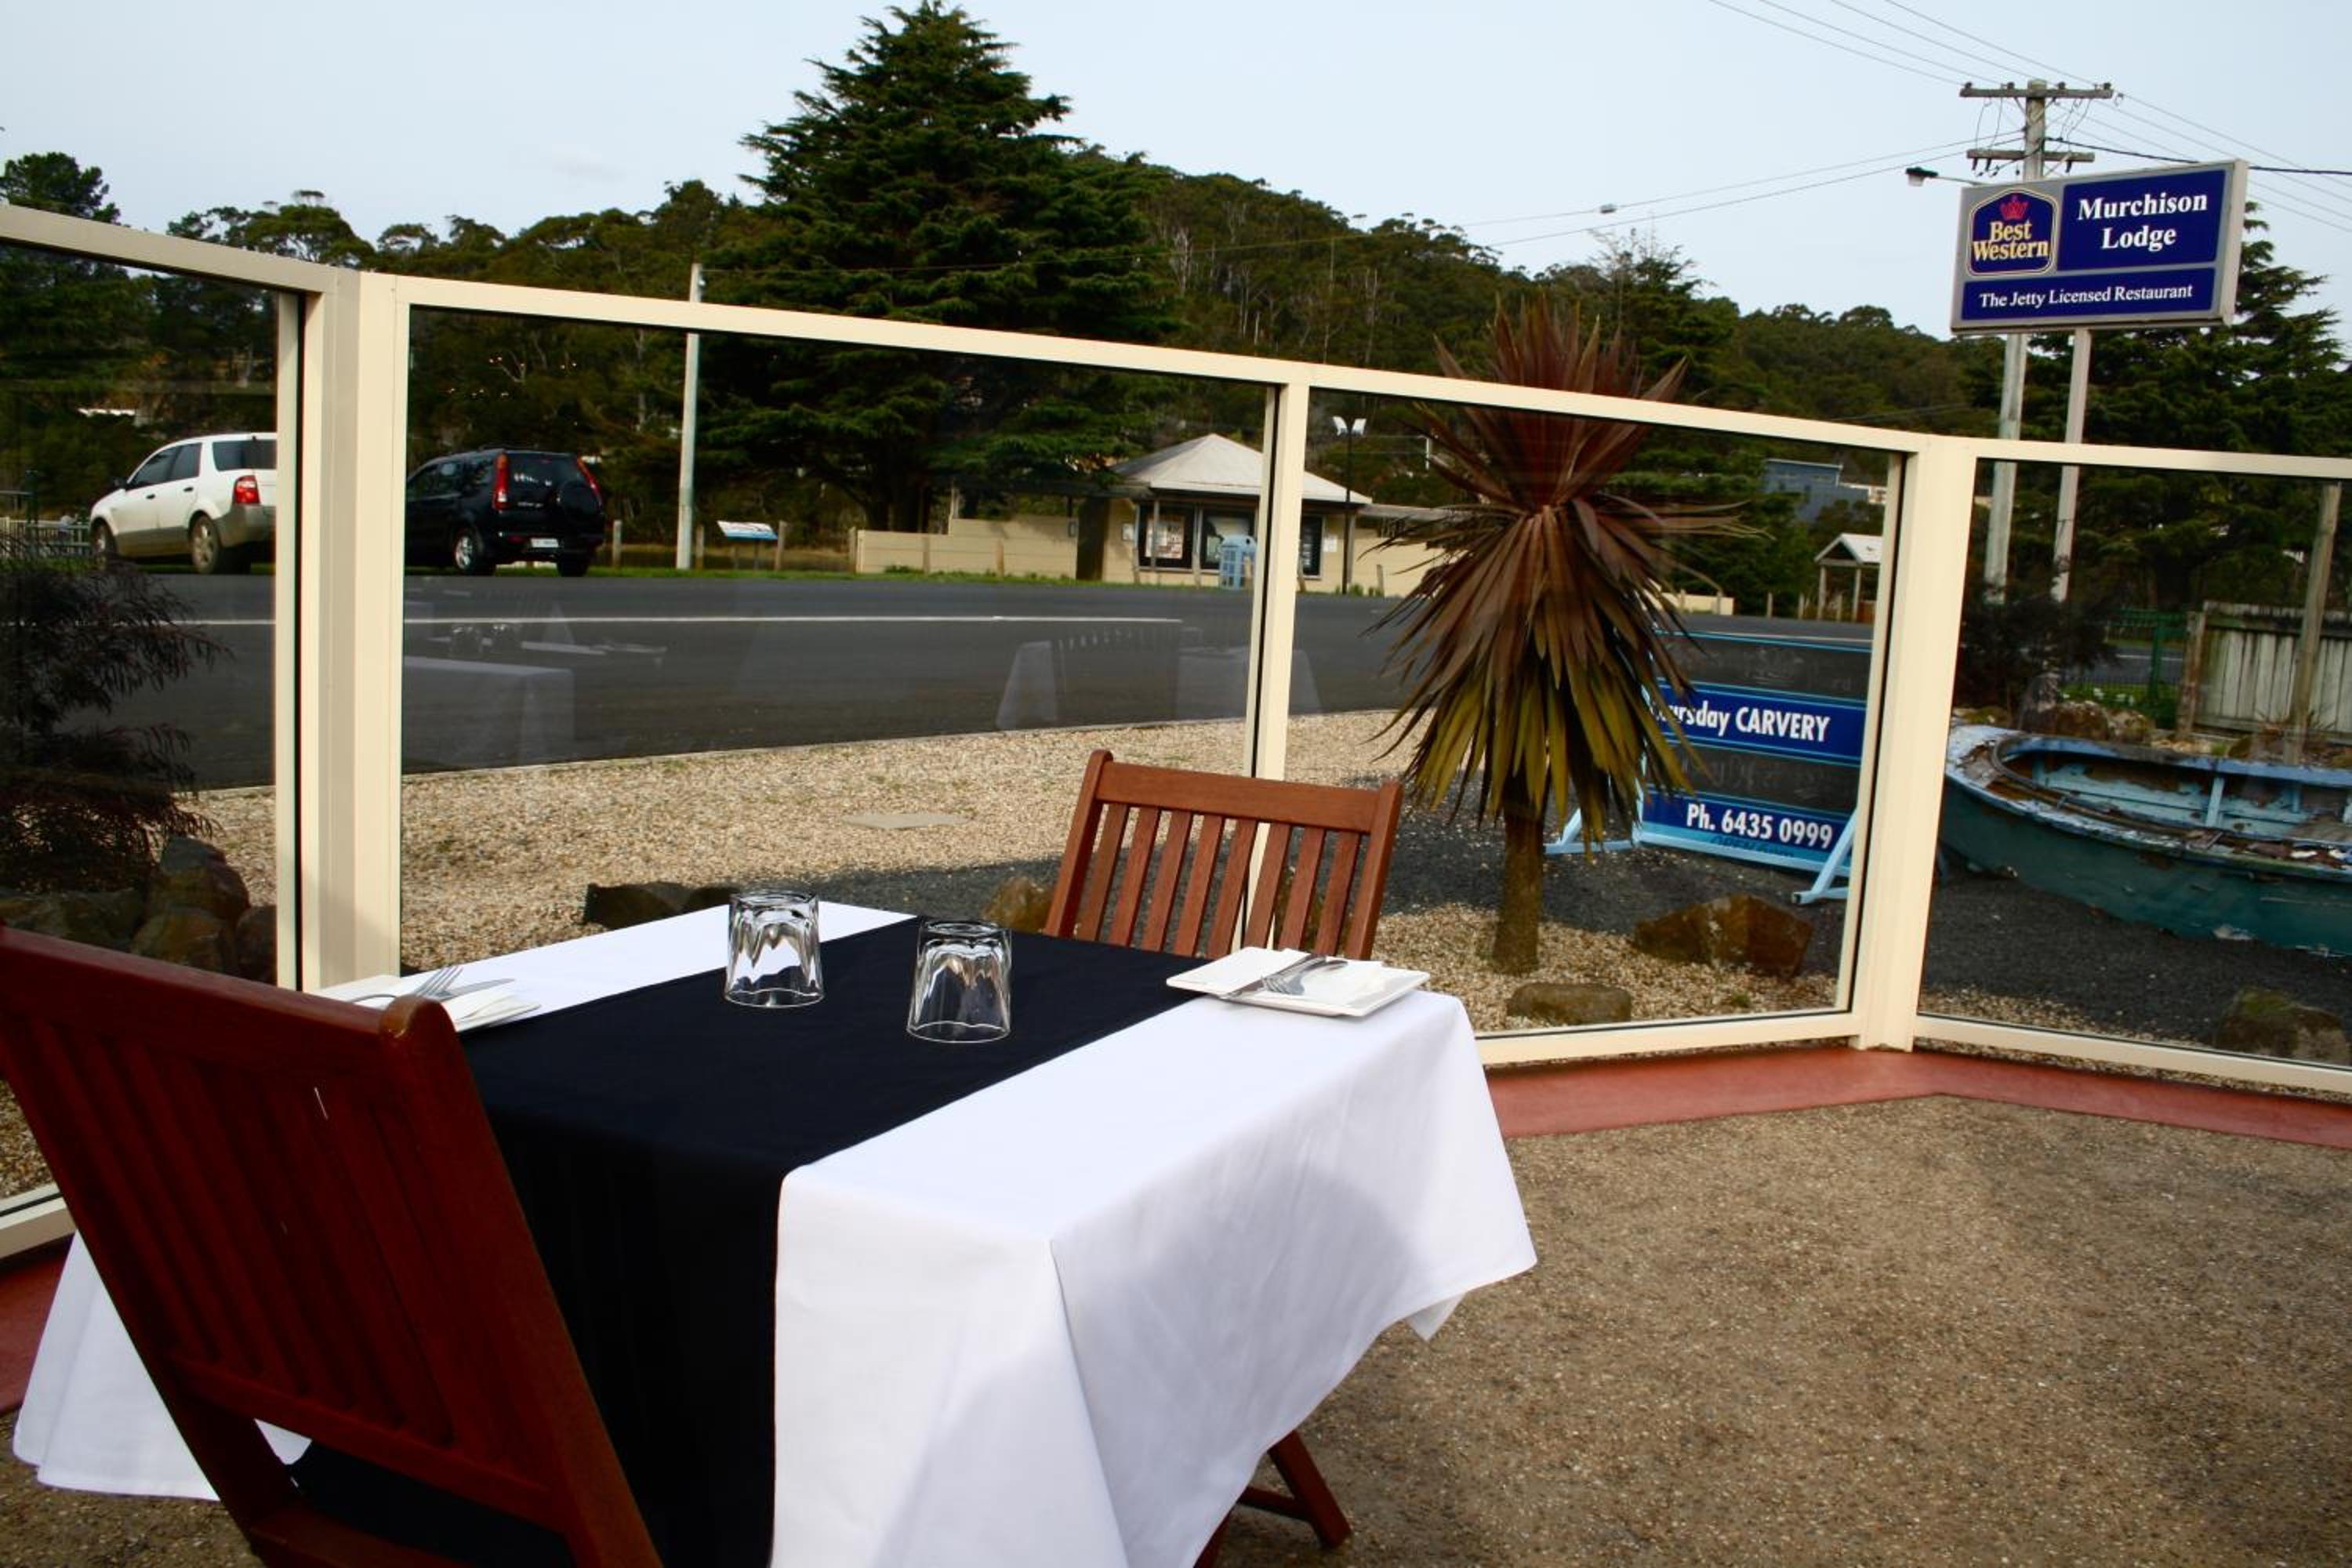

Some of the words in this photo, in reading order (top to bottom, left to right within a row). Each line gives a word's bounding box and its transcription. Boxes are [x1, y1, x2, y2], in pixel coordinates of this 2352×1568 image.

[2078, 191, 2208, 220] Murchison
[1990, 220, 2032, 242] Best
[2101, 226, 2176, 252] Lodge
[1973, 239, 2049, 261] Western
[1980, 292, 2008, 307] The
[2009, 291, 2045, 308] Jetty
[2049, 286, 2111, 304] Licensed
[2114, 285, 2193, 302] Restaurant
[1736, 706, 1830, 742] CARVERY
[1686, 802, 1716, 831] Ph.
[1721, 809, 1773, 840] 6435
[1779, 818, 1833, 850] 0999
